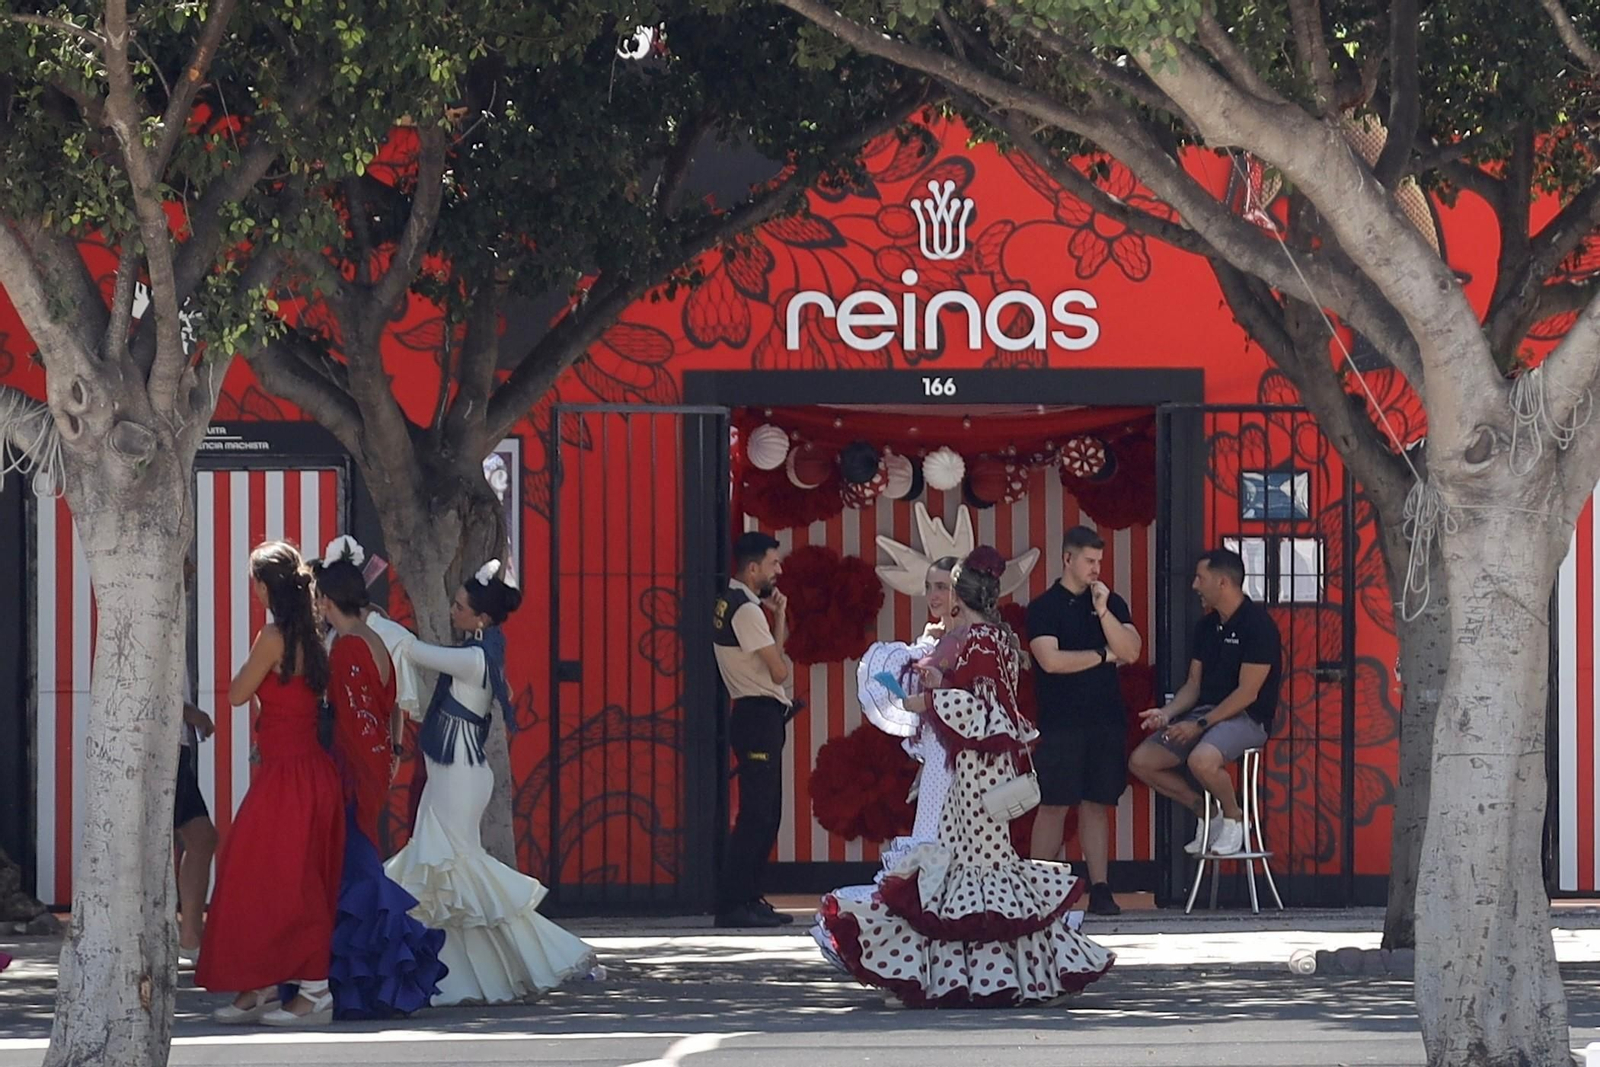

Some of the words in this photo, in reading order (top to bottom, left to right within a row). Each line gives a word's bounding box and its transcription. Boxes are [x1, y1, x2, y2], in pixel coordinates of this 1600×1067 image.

[786, 269, 1100, 351] reinas
[922, 377, 957, 396] 166
[224, 441, 270, 450] MACHISTA
